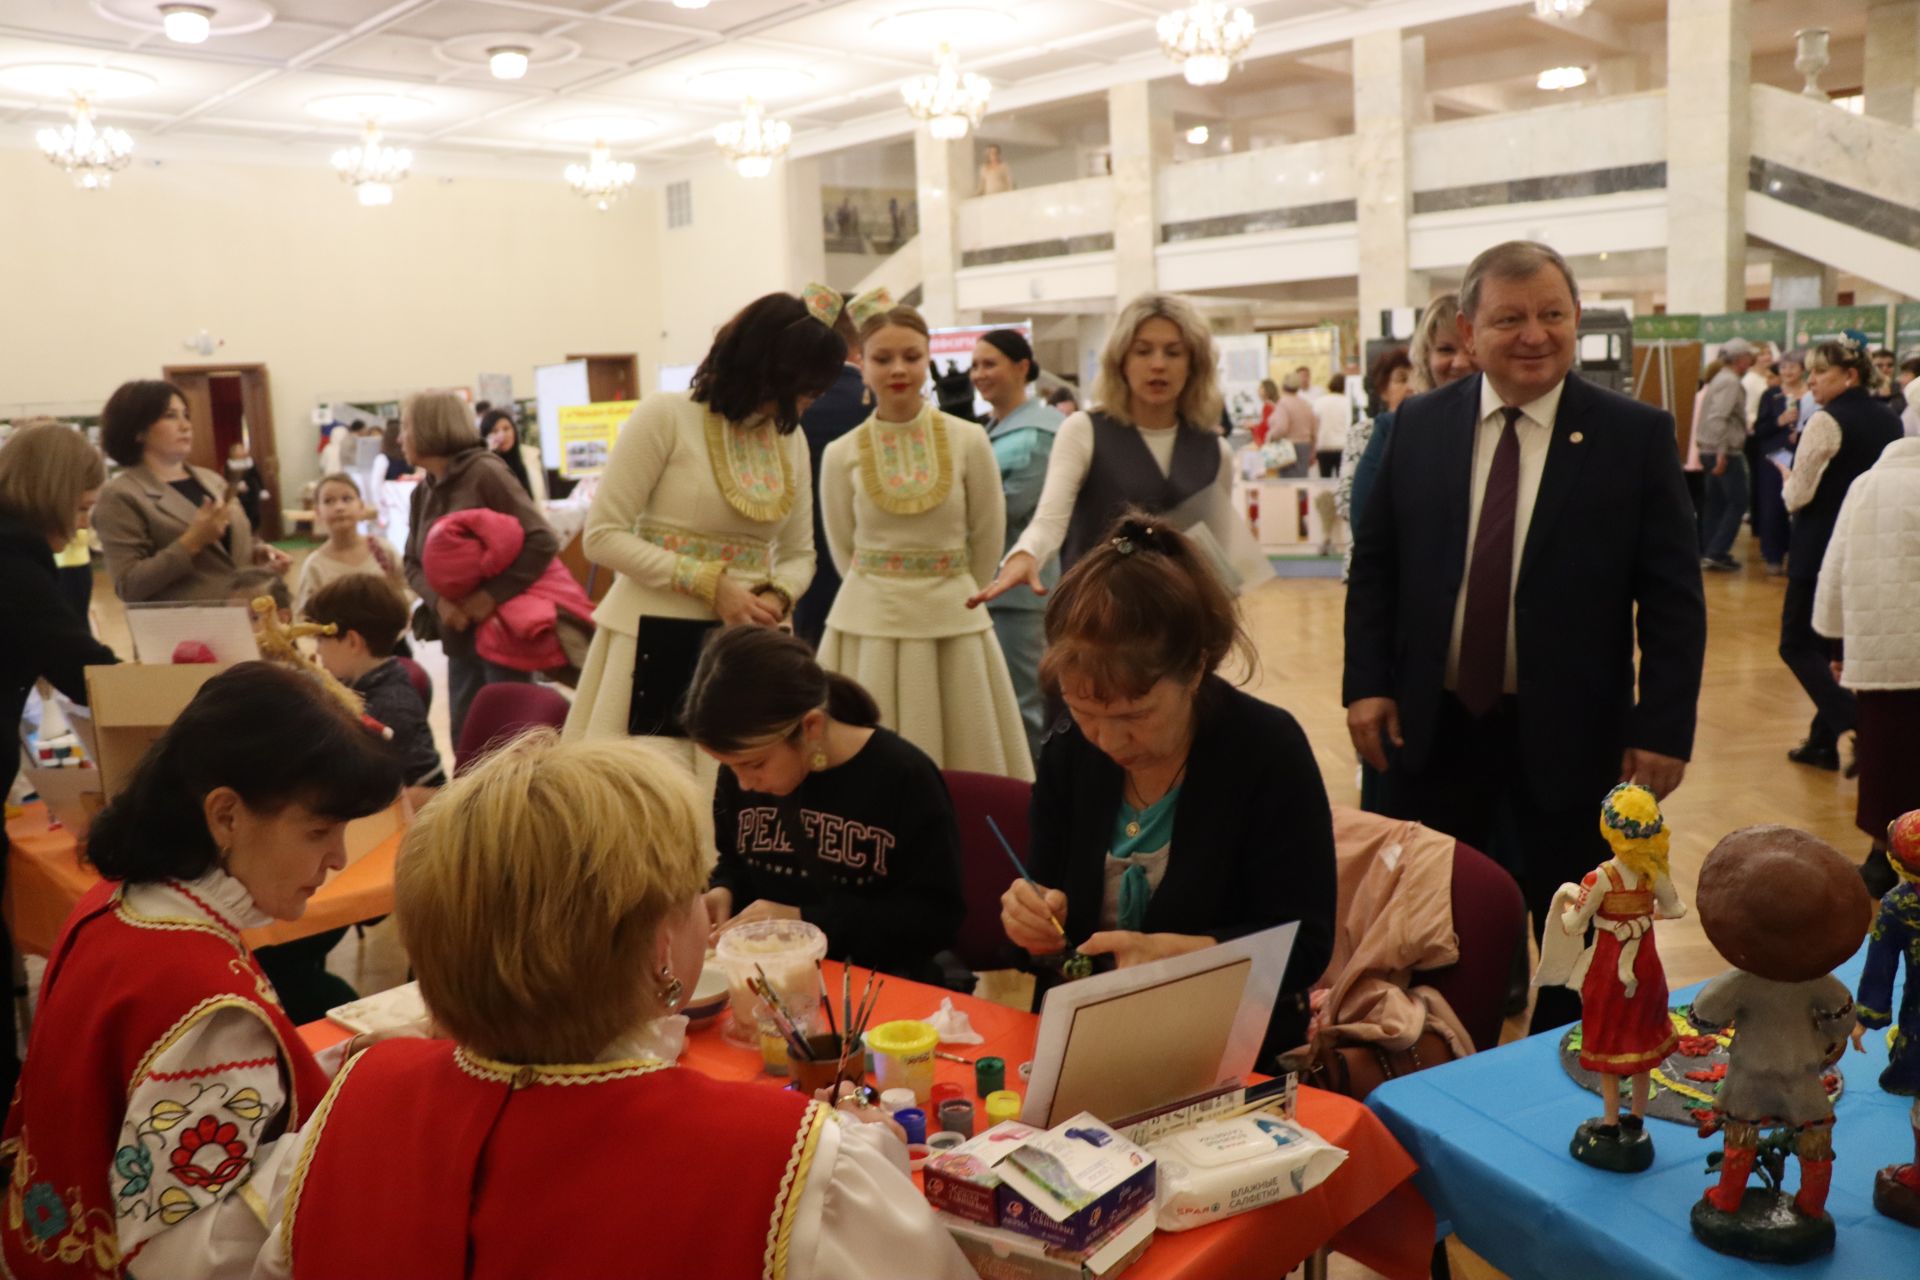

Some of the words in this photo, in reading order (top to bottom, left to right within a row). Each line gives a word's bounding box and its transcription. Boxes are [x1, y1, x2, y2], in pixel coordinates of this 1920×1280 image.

[1229, 1187, 1280, 1209] САЛФЕТКИ
[1230, 1176, 1279, 1198] ВЛАЖНЫЕ
[1176, 1205, 1210, 1217] SPAR
